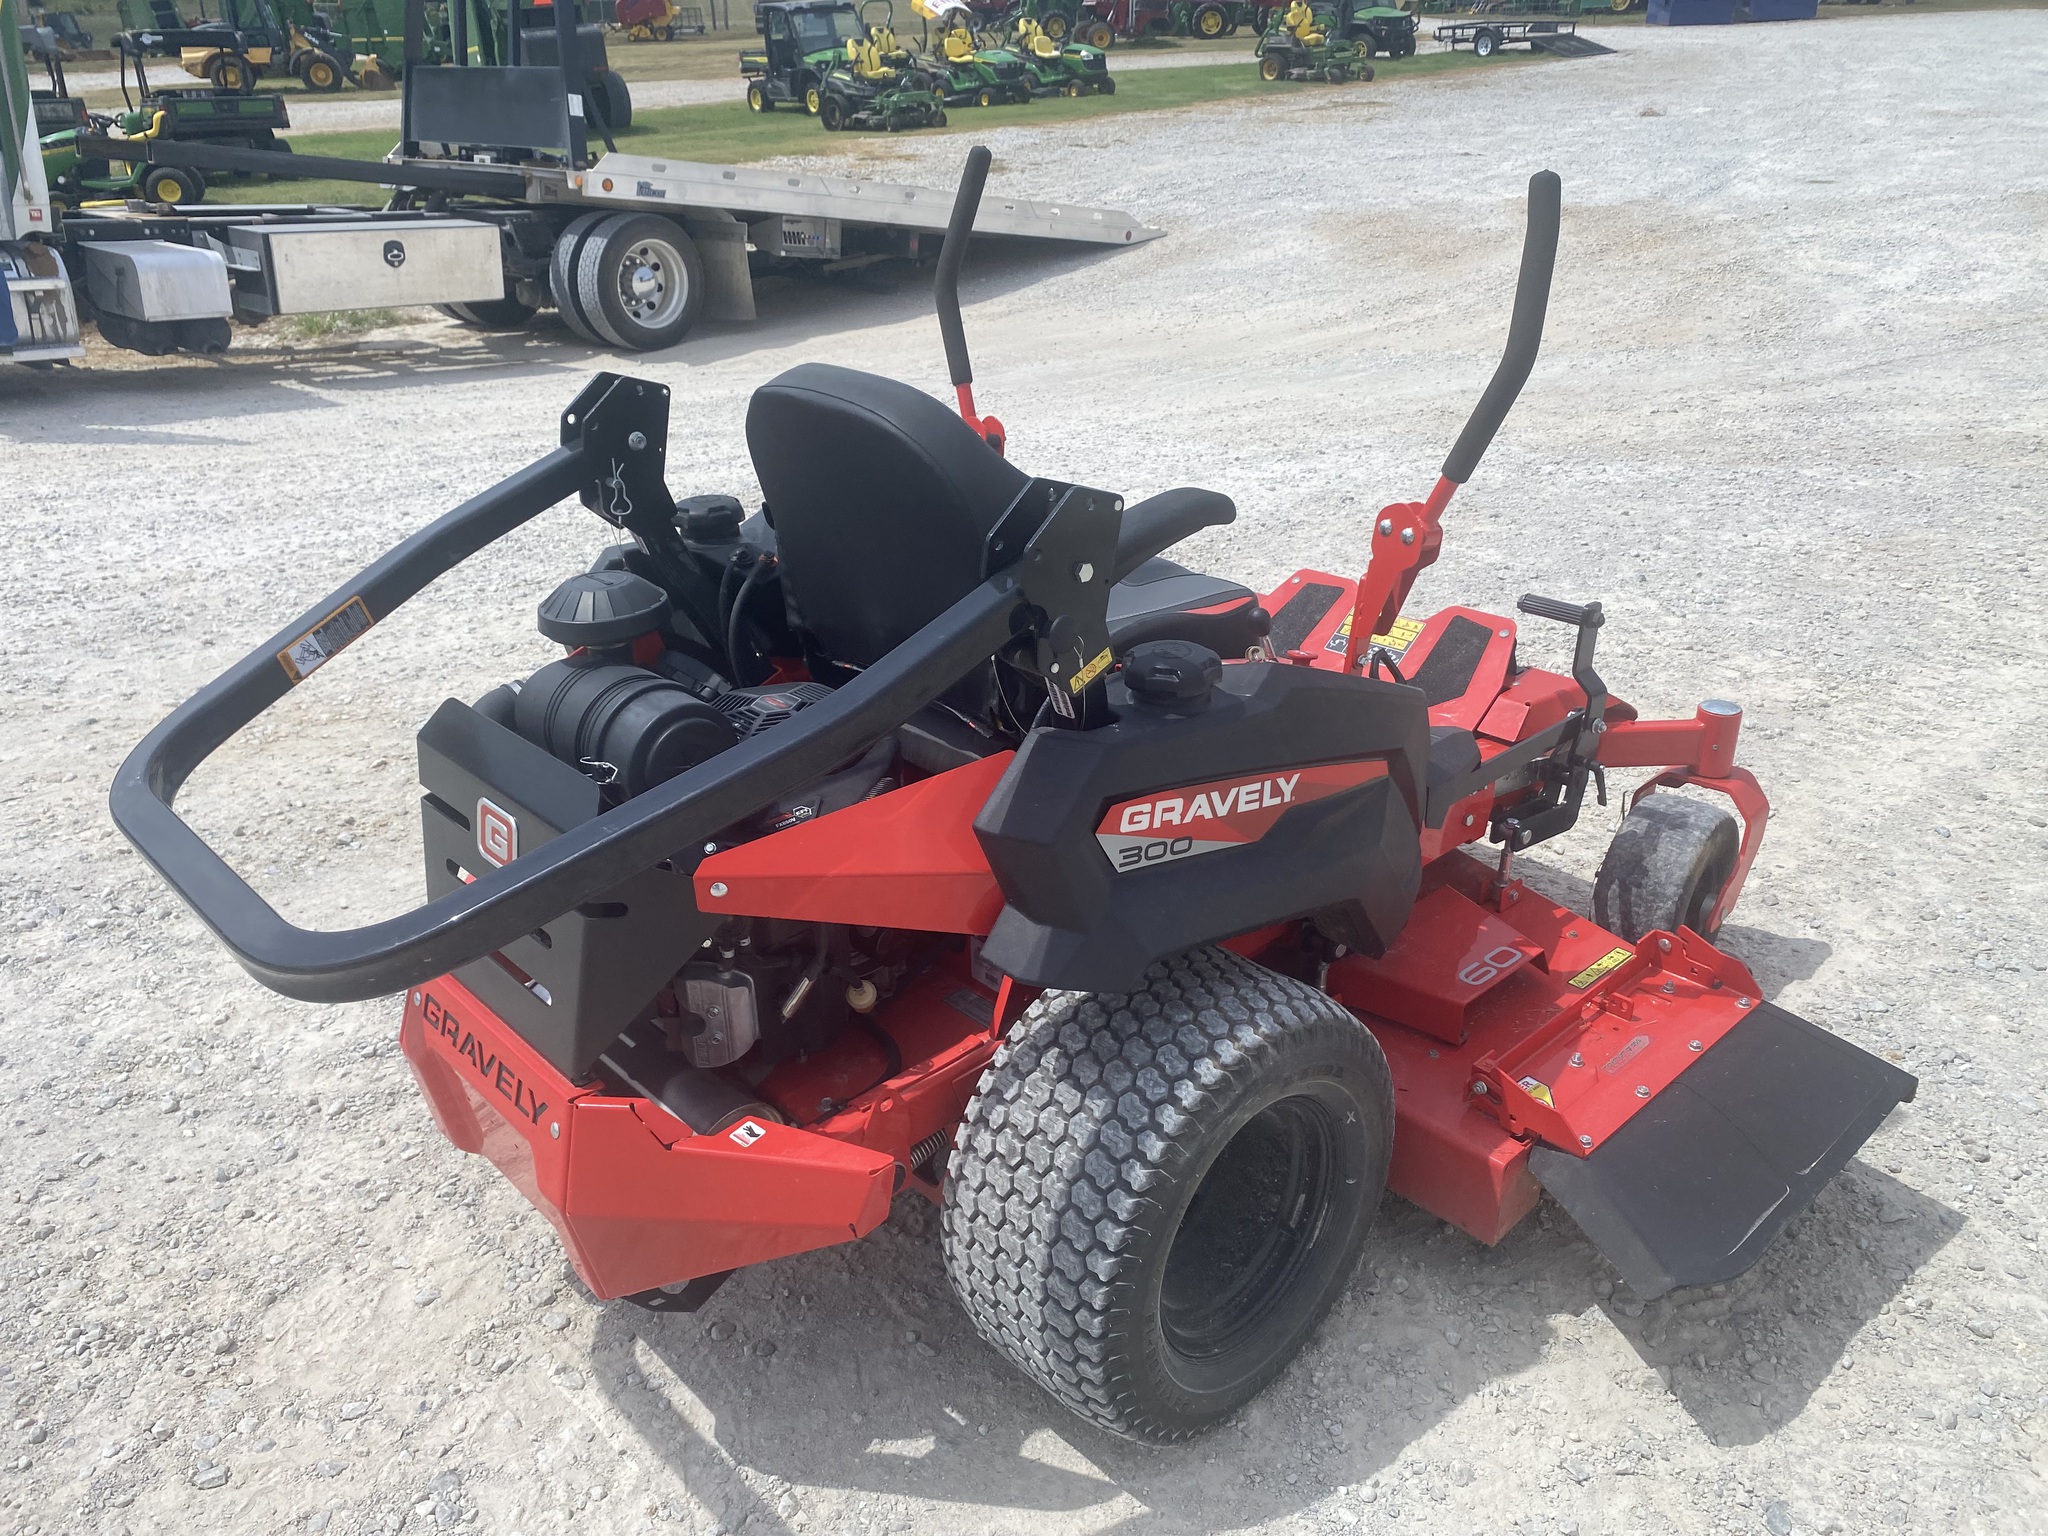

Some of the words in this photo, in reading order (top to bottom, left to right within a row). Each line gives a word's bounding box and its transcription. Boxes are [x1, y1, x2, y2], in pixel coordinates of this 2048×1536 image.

[1119, 773, 1301, 834] GRAVELY
[485, 813, 508, 861] G
[1118, 836, 1193, 869] 300
[1458, 946, 1523, 985] 60
[423, 993, 549, 1126] GRAVELY
